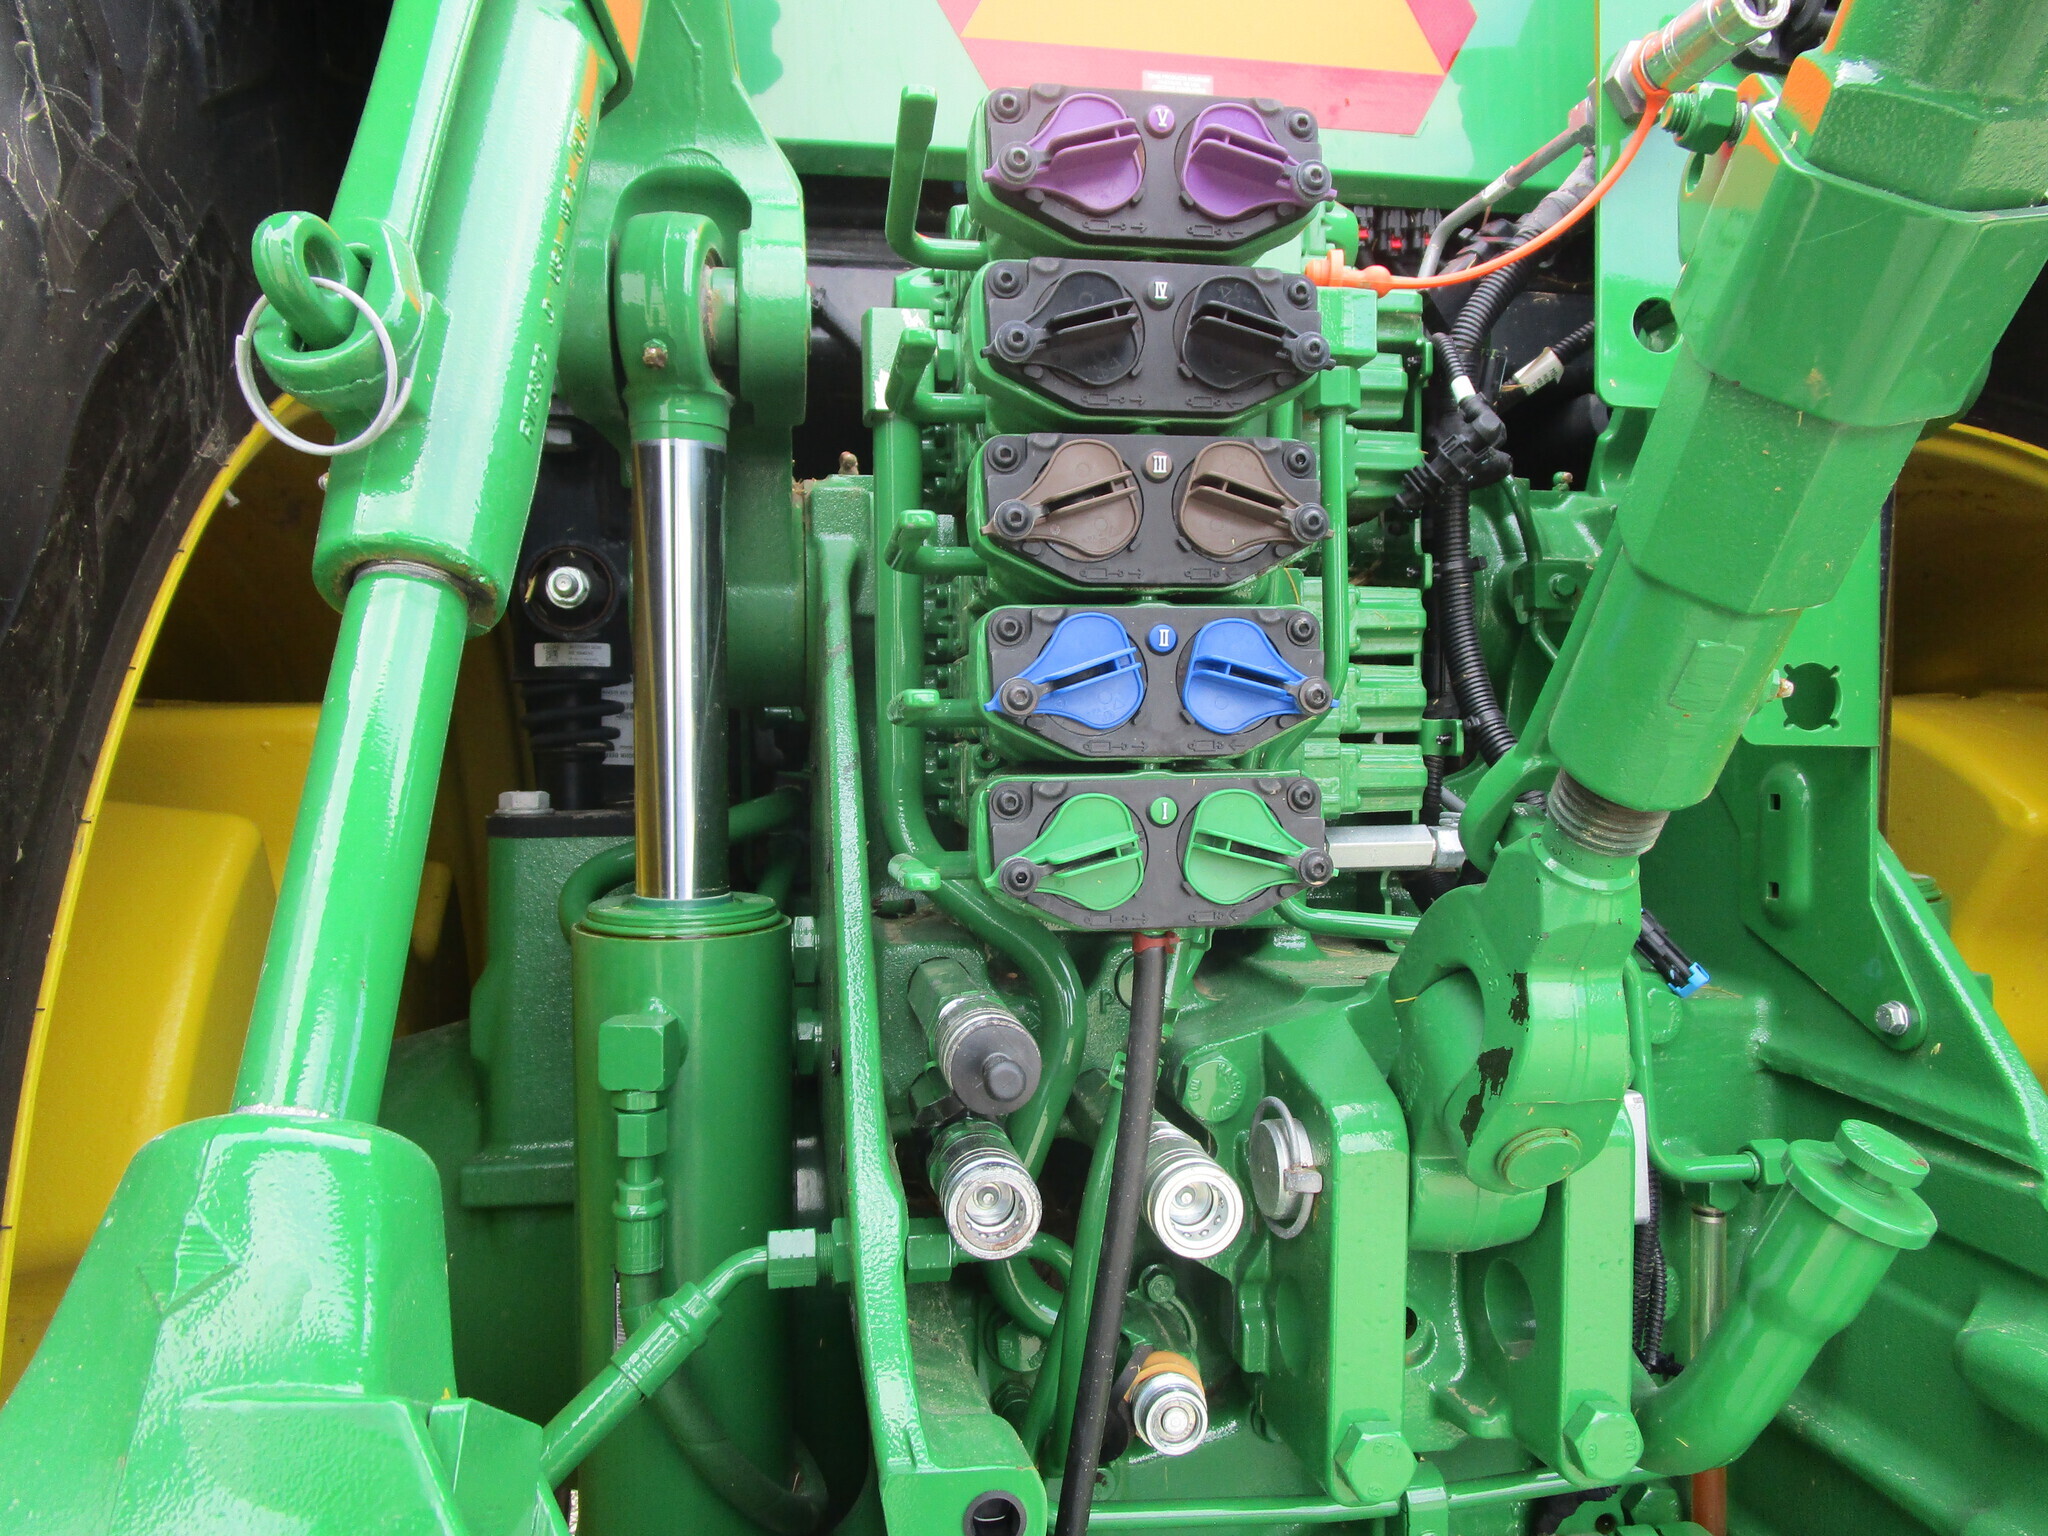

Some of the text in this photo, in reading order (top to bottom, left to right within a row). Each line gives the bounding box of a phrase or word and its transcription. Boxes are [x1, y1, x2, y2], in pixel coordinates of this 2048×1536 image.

[1155, 108, 1170, 127] V
[1154, 281, 1168, 299] IV
[1153, 455, 1168, 473] III
[1158, 629, 1170, 647] II
[1162, 802, 1168, 820] I
